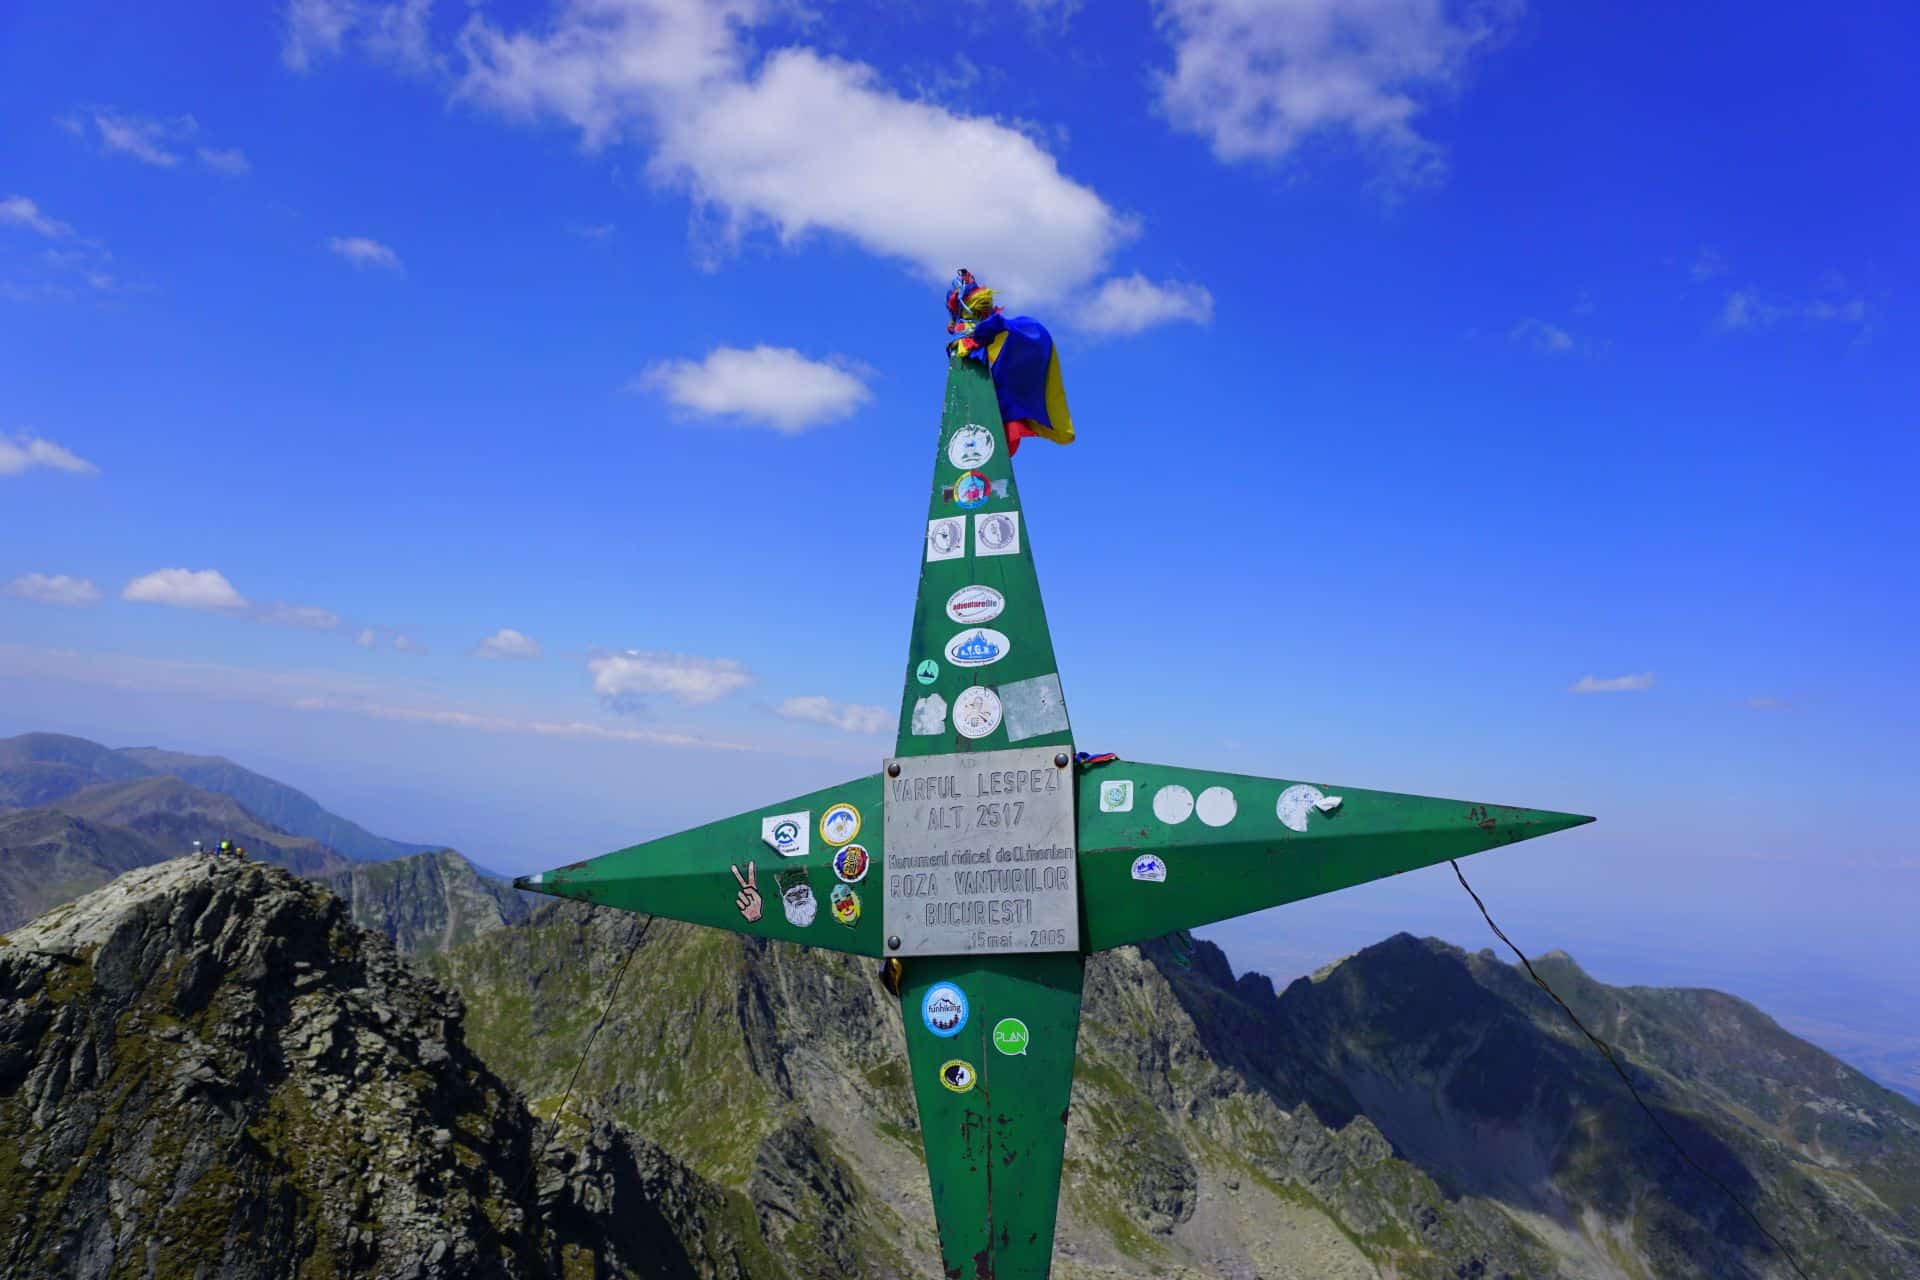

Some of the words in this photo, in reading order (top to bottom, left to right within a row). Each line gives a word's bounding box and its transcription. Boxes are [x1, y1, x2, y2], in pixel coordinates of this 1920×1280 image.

[977, 767, 1061, 798] LESPEZI
[976, 801, 1025, 828] 2517
[890, 872, 937, 898] ROZA
[954, 865, 1069, 896] VANTURILOR
[925, 898, 1032, 928] BUCURESTI
[1030, 929, 1065, 947] 2005
[928, 1004, 961, 1013] funhiking
[996, 1031, 1025, 1042] PLAN
